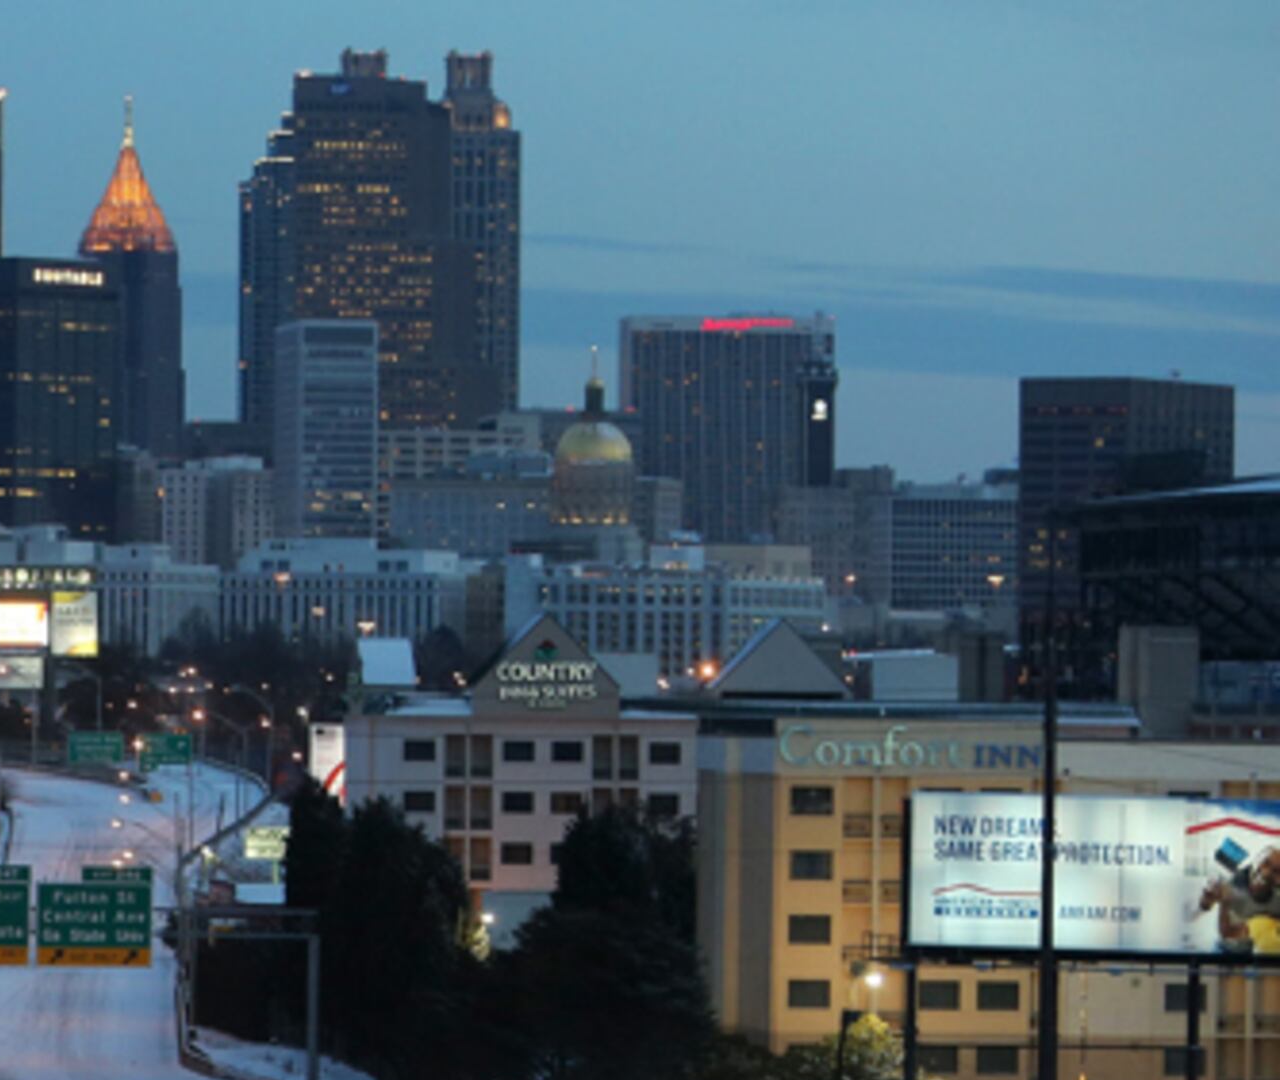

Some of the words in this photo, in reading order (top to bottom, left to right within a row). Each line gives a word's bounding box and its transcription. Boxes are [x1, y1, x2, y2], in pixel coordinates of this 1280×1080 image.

[496, 661, 597, 681] COUNTRY
[779, 723, 965, 767] Comfort
[974, 744, 1042, 769] INN
[933, 815, 976, 836] NEW
[933, 841, 984, 862] SAME
[53, 890, 109, 904] Fulton
[43, 908, 106, 923] Central
[114, 909, 145, 923] Ave
[69, 927, 106, 943] State
